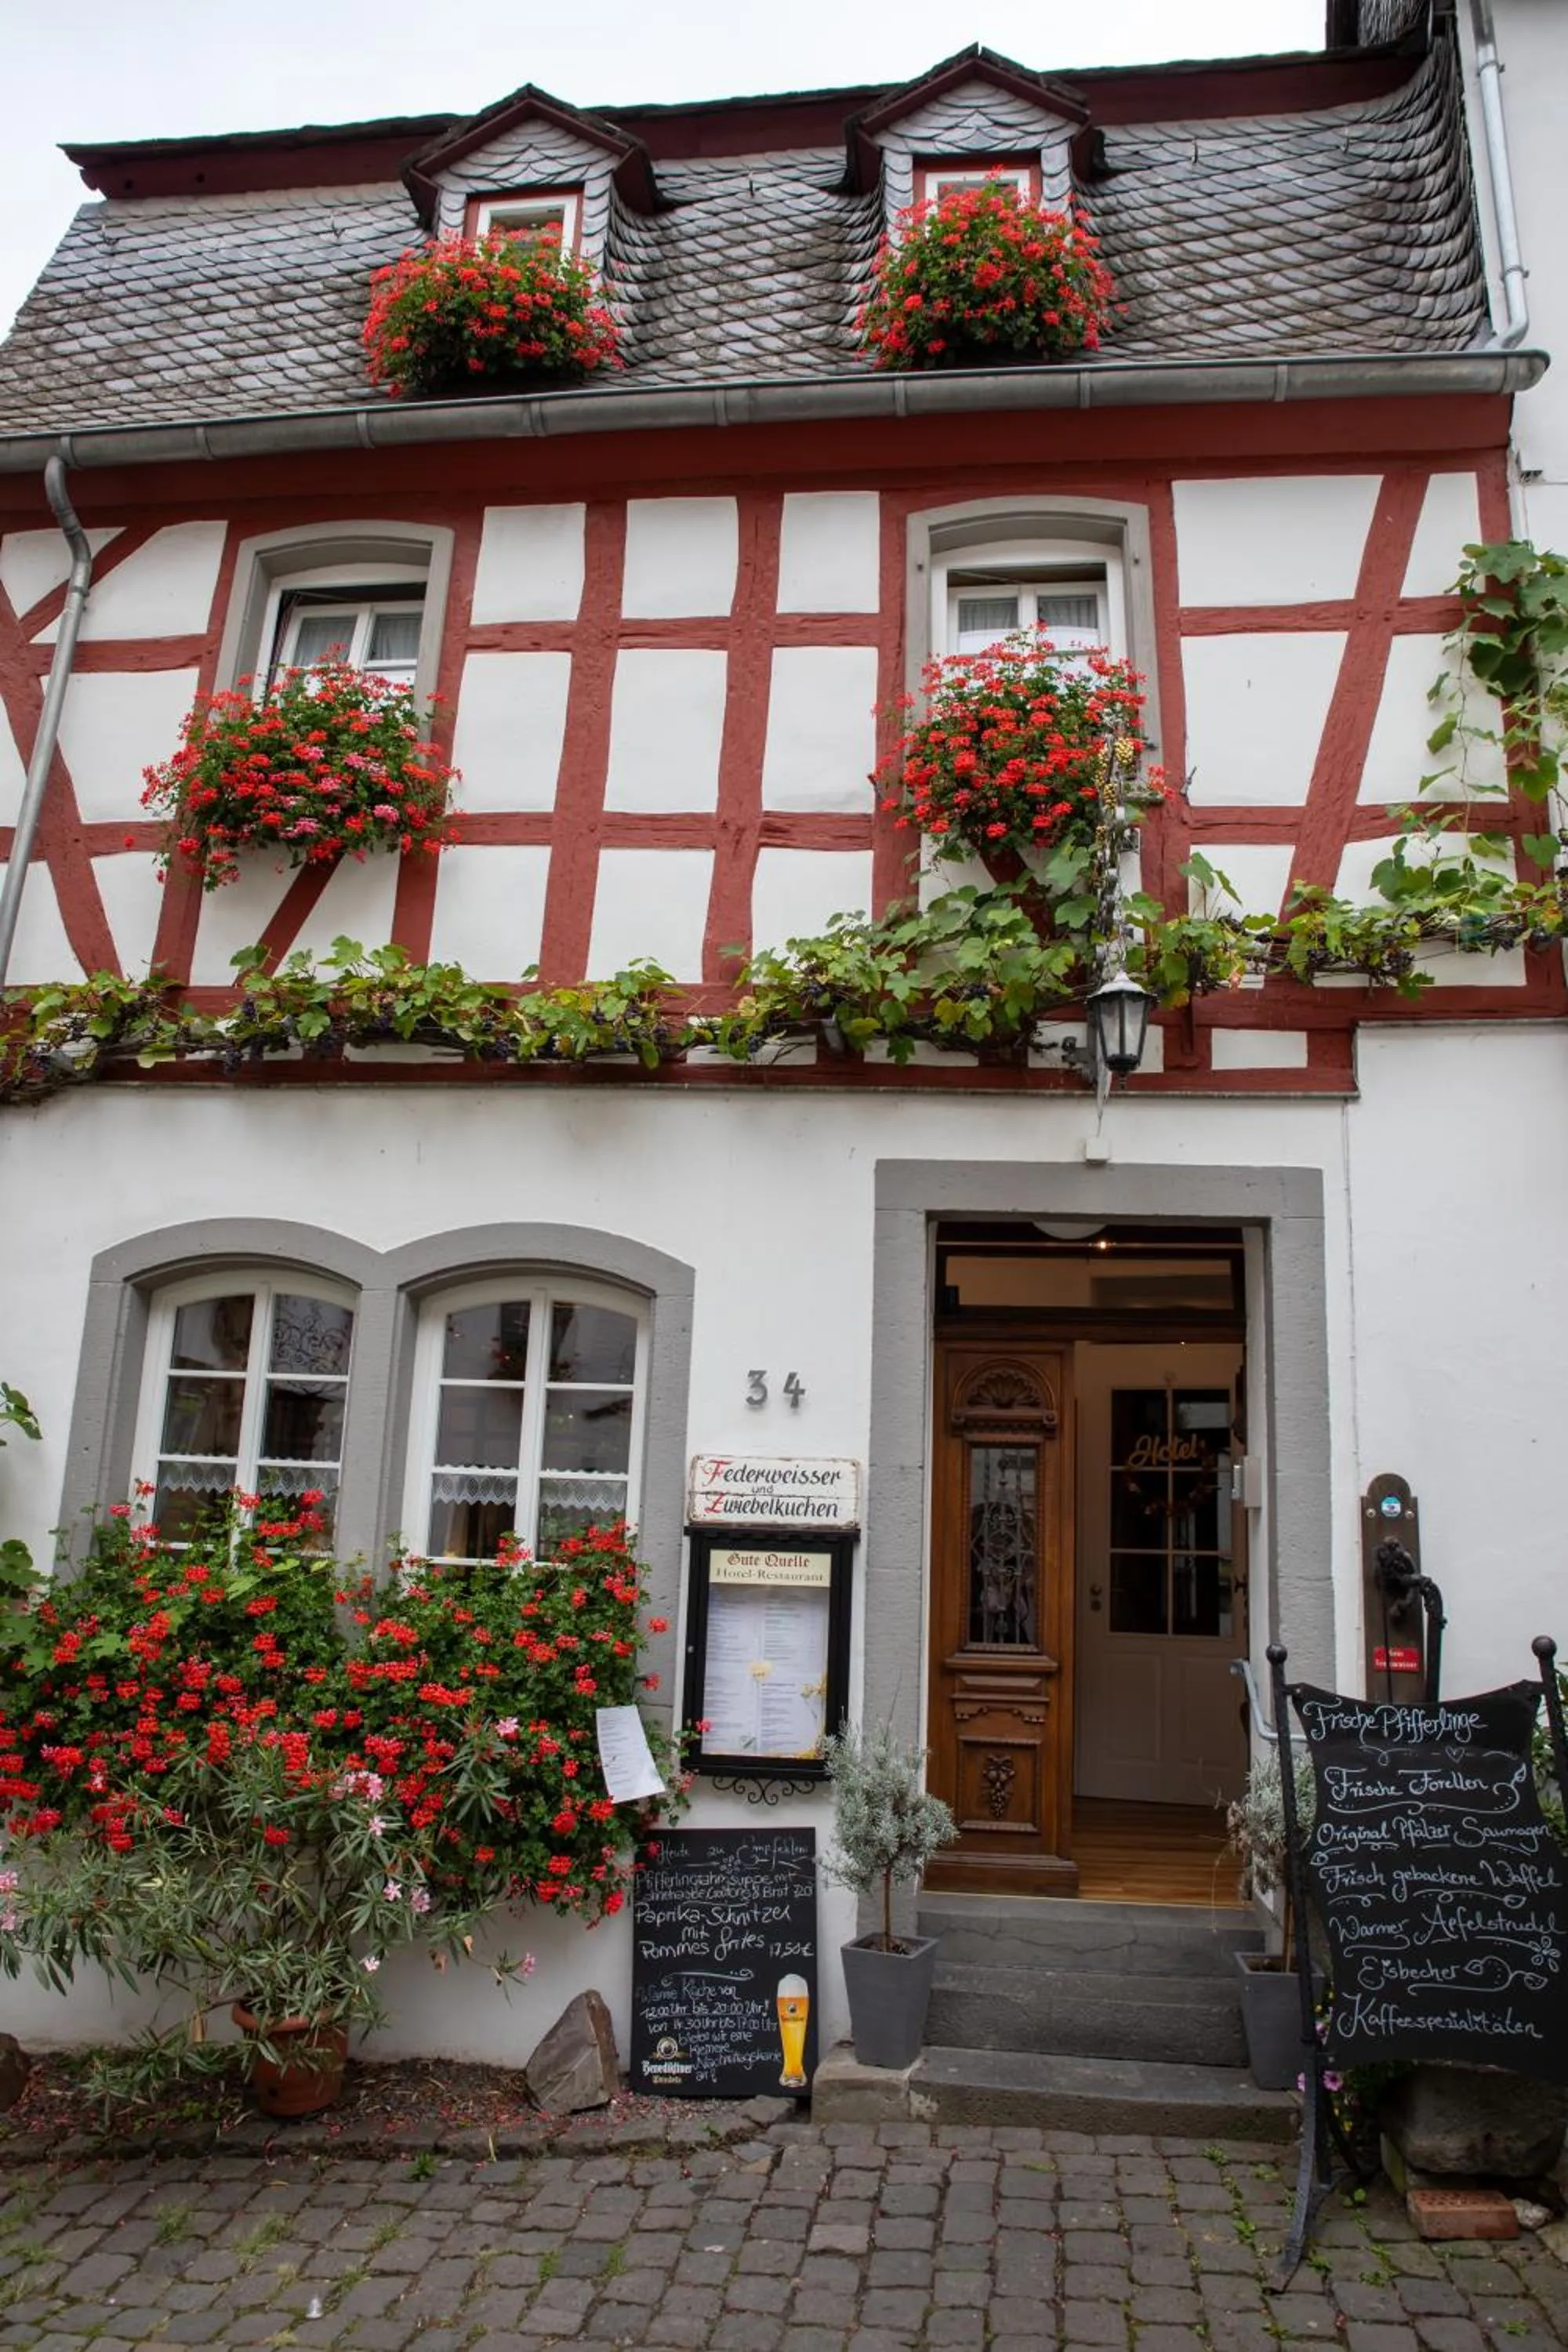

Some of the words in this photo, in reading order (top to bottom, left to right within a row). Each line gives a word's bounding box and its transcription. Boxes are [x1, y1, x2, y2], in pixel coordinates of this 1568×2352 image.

[1129, 1433, 1197, 1467] Hotel
[702, 1460, 841, 1487] Federweisser
[751, 1484, 774, 1494] und
[704, 1493, 838, 1519] Zwiebelkuchen
[727, 1552, 760, 1566] Gute
[764, 1553, 811, 1569] Quelle
[1302, 1697, 1380, 1741] Frische
[1374, 1705, 1489, 1744] Pfifferlinge
[1325, 1766, 1402, 1801] Frische
[1399, 1769, 1488, 1795] Forellen
[1317, 1822, 1391, 1852] Original
[1392, 1816, 1451, 1848] Pfälzer
[1453, 1817, 1552, 1853] Saumagen
[1318, 1862, 1387, 1893] Frisch
[1392, 1864, 1483, 1903] gebackene
[1479, 1859, 1563, 1893] Waffel
[681, 1926, 710, 1942] mit
[1329, 1915, 1410, 1942] Warmer
[1414, 1903, 1567, 1945] Apfelstrudel
[639, 1940, 710, 1960] Pommes
[1358, 1956, 1461, 1991] Eisbecher
[1337, 1992, 1544, 2038] Kaffeespezialitäten
